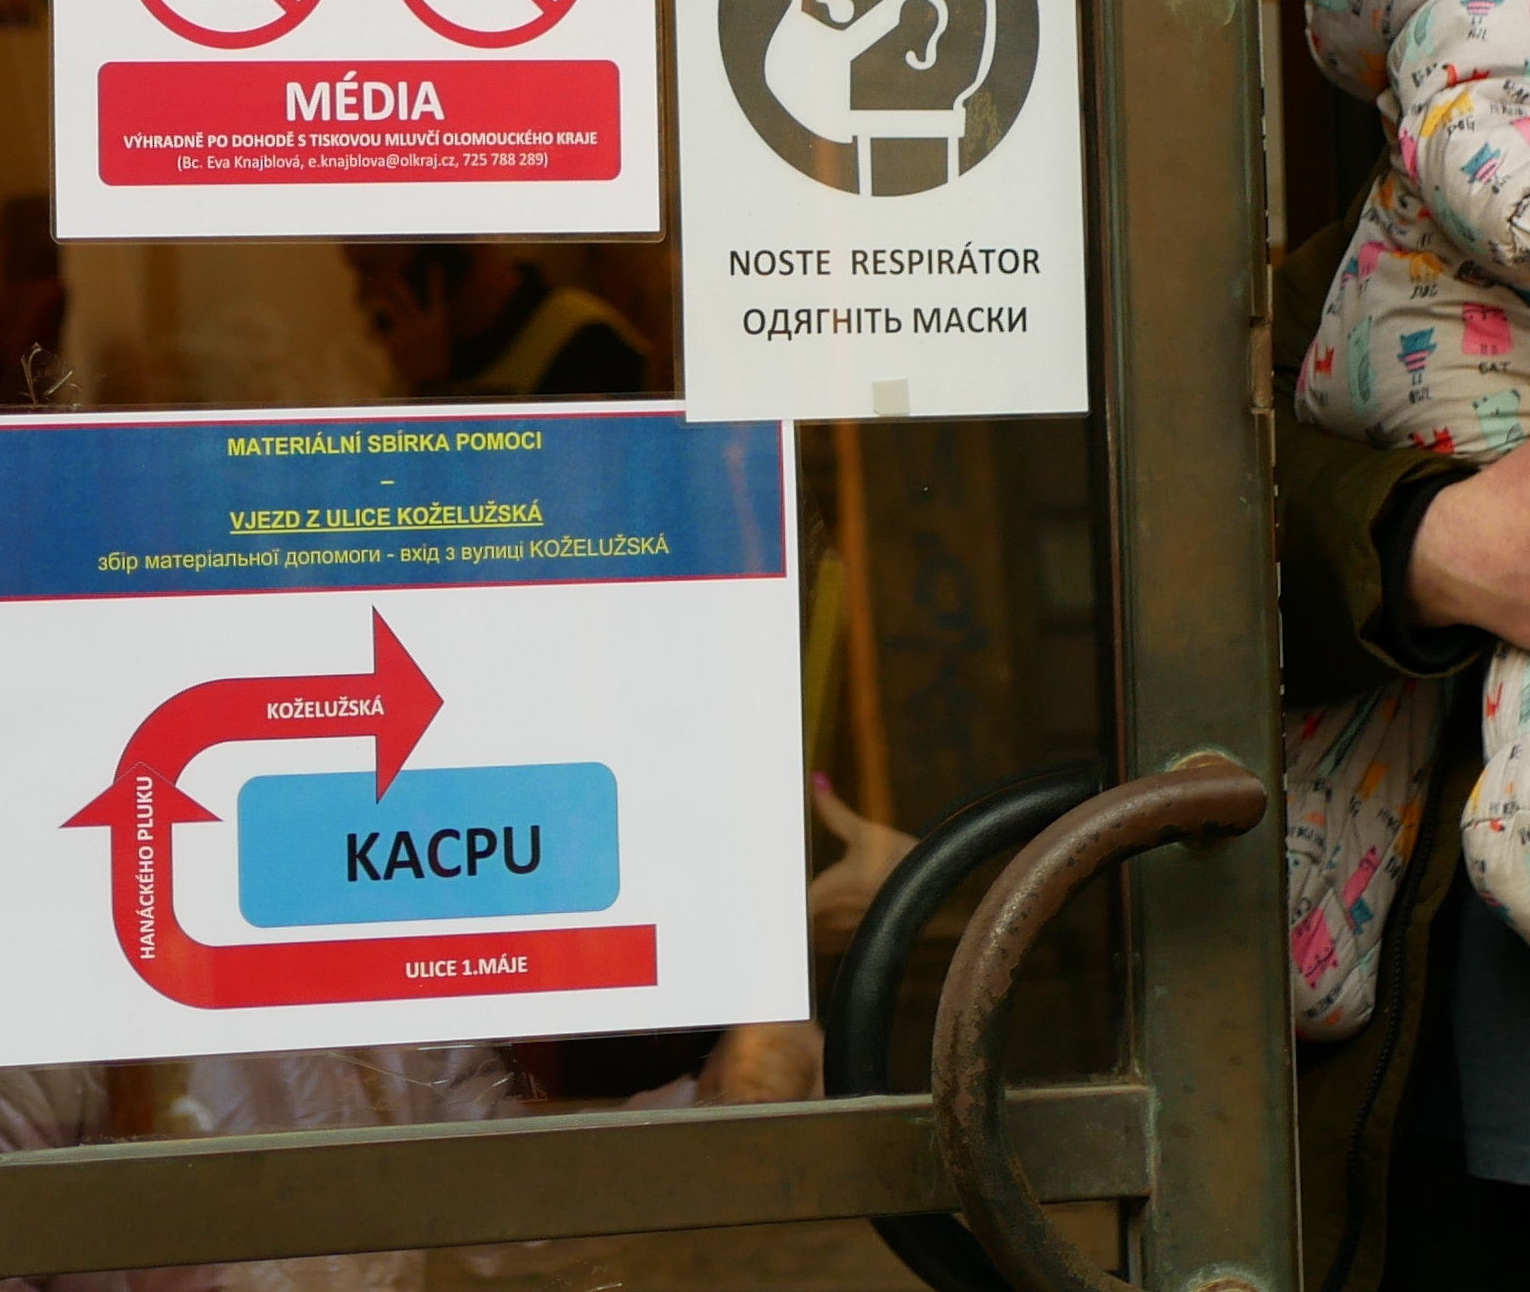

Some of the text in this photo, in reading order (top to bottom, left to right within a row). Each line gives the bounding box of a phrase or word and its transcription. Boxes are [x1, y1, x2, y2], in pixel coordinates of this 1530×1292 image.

[285, 70, 445, 123] MÉDIA
[123, 129, 598, 149] VÝHRADNĚ PO DOHODĚ S TISKOVOU MLUVČÍ OLOMOUCKÉHO KRAJE
[177, 152, 548, 172] (Bc. Eva Knajblová, e.knajblova@olkraj.cz, 725 788 289)
[729, 241, 1041, 277] NOSTE RESPIRÁTOR
[743, 305, 1029, 342] ОДЯГНІТЬ МАСКИ
[1478, 360, 1512, 375] CAT
[227, 429, 543, 456] MATERIÁLNÍ SBÍRKA POMOCI
[229, 499, 543, 531] VJEZD Z ULICE KOŽELUŽSKÁ
[98, 551, 138, 574] збір
[145, 549, 280, 572] матеріальної
[284, 549, 381, 569] допомоги
[400, 543, 440, 565] вхід
[445, 546, 455, 561] з
[460, 540, 524, 565] вулиці
[530, 533, 669, 558] KOŽELUŽSKÁ
[267, 695, 385, 720] KOŽELUŽSKÁ
[135, 776, 156, 959] HANÁCKÉHO PLUKU
[346, 825, 541, 882] KACPU
[405, 953, 529, 979] ULICE 1.MÁJE
